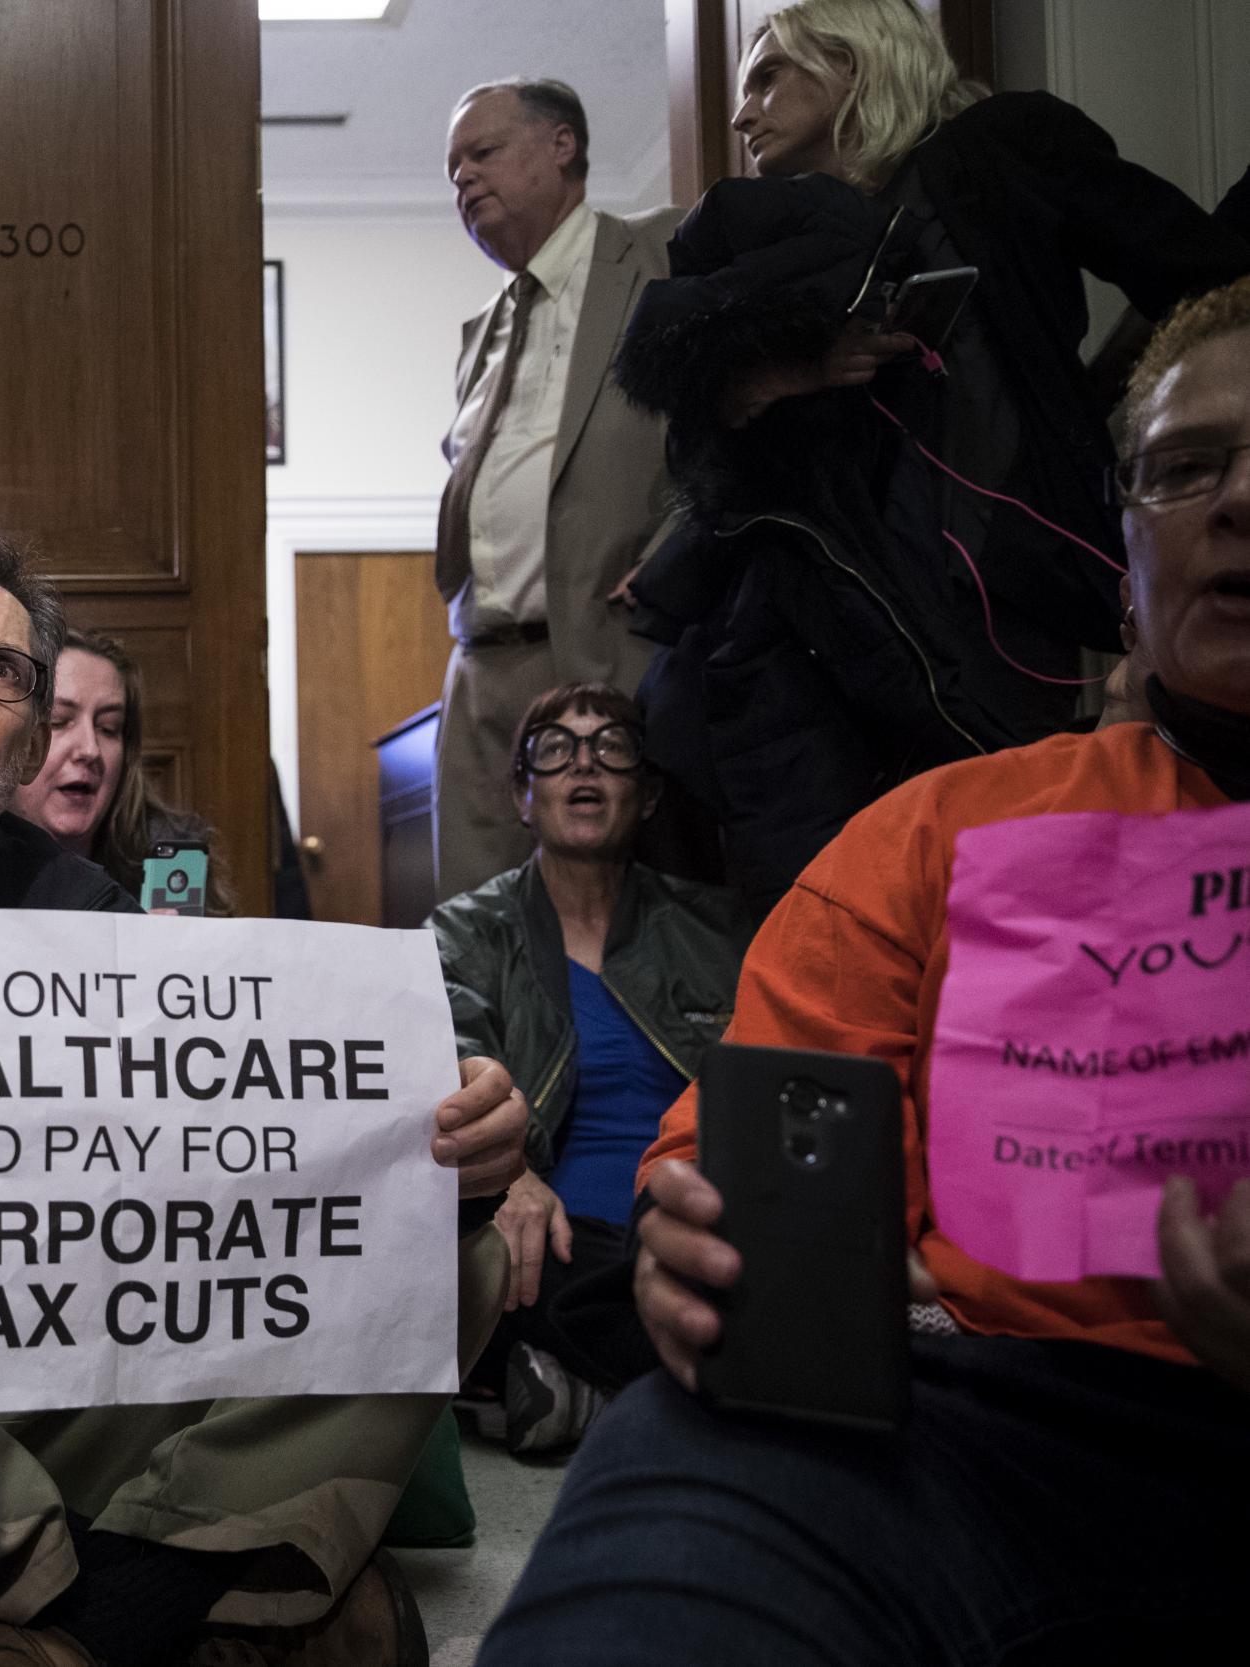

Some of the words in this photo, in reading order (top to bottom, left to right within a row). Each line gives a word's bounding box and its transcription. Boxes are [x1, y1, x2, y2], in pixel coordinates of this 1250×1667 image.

[1190, 866, 1250, 917] PI
[157, 973, 274, 1021] GUT
[1001, 1038, 1119, 1080] NAME
[1127, 1038, 1173, 1074] OF
[1185, 1029, 1250, 1067] EM
[43, 1124, 162, 1174] PAY
[181, 1125, 300, 1174] FOR
[993, 1134, 1085, 1172] Date
[104, 1272, 312, 1347] CUTS
